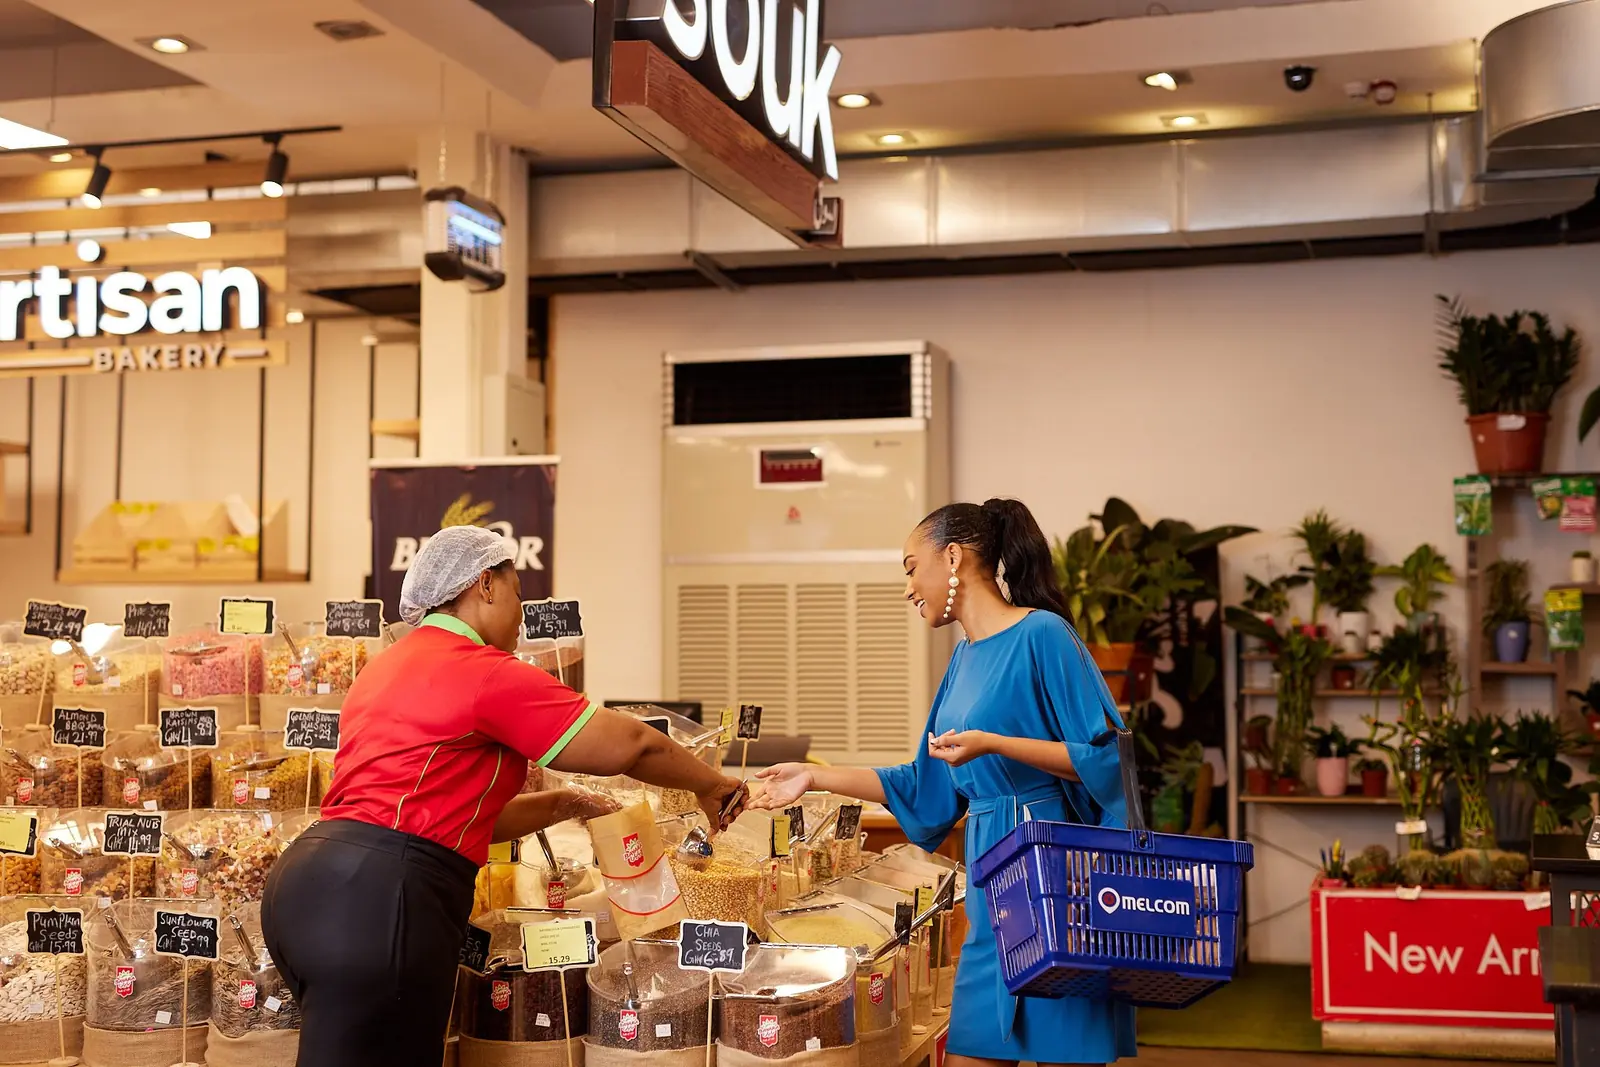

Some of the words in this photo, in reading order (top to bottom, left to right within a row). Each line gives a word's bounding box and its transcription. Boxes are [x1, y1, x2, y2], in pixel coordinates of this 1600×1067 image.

[93, 343, 225, 372] BAKERY
[525, 603, 570, 616] QUINOA
[539, 612, 559, 622] RED
[545, 619, 567, 633] 5.99
[165, 717, 199, 728] RAISINS
[72, 730, 98, 746] 21.99
[304, 729, 331, 746] 5.29
[108, 815, 135, 828] TRIAL
[1121, 895, 1190, 916] MELCOM
[160, 912, 215, 930] SUNFLOWER
[40, 927, 78, 942] Seeds
[171, 925, 197, 939] SEED
[695, 924, 720, 938] CHIA
[50, 940, 76, 953] 15.99
[179, 935, 209, 953] 5.99
[695, 938, 722, 952] SEEDS
[548, 954, 571, 964] 15.29
[1363, 930, 1464, 974] New
